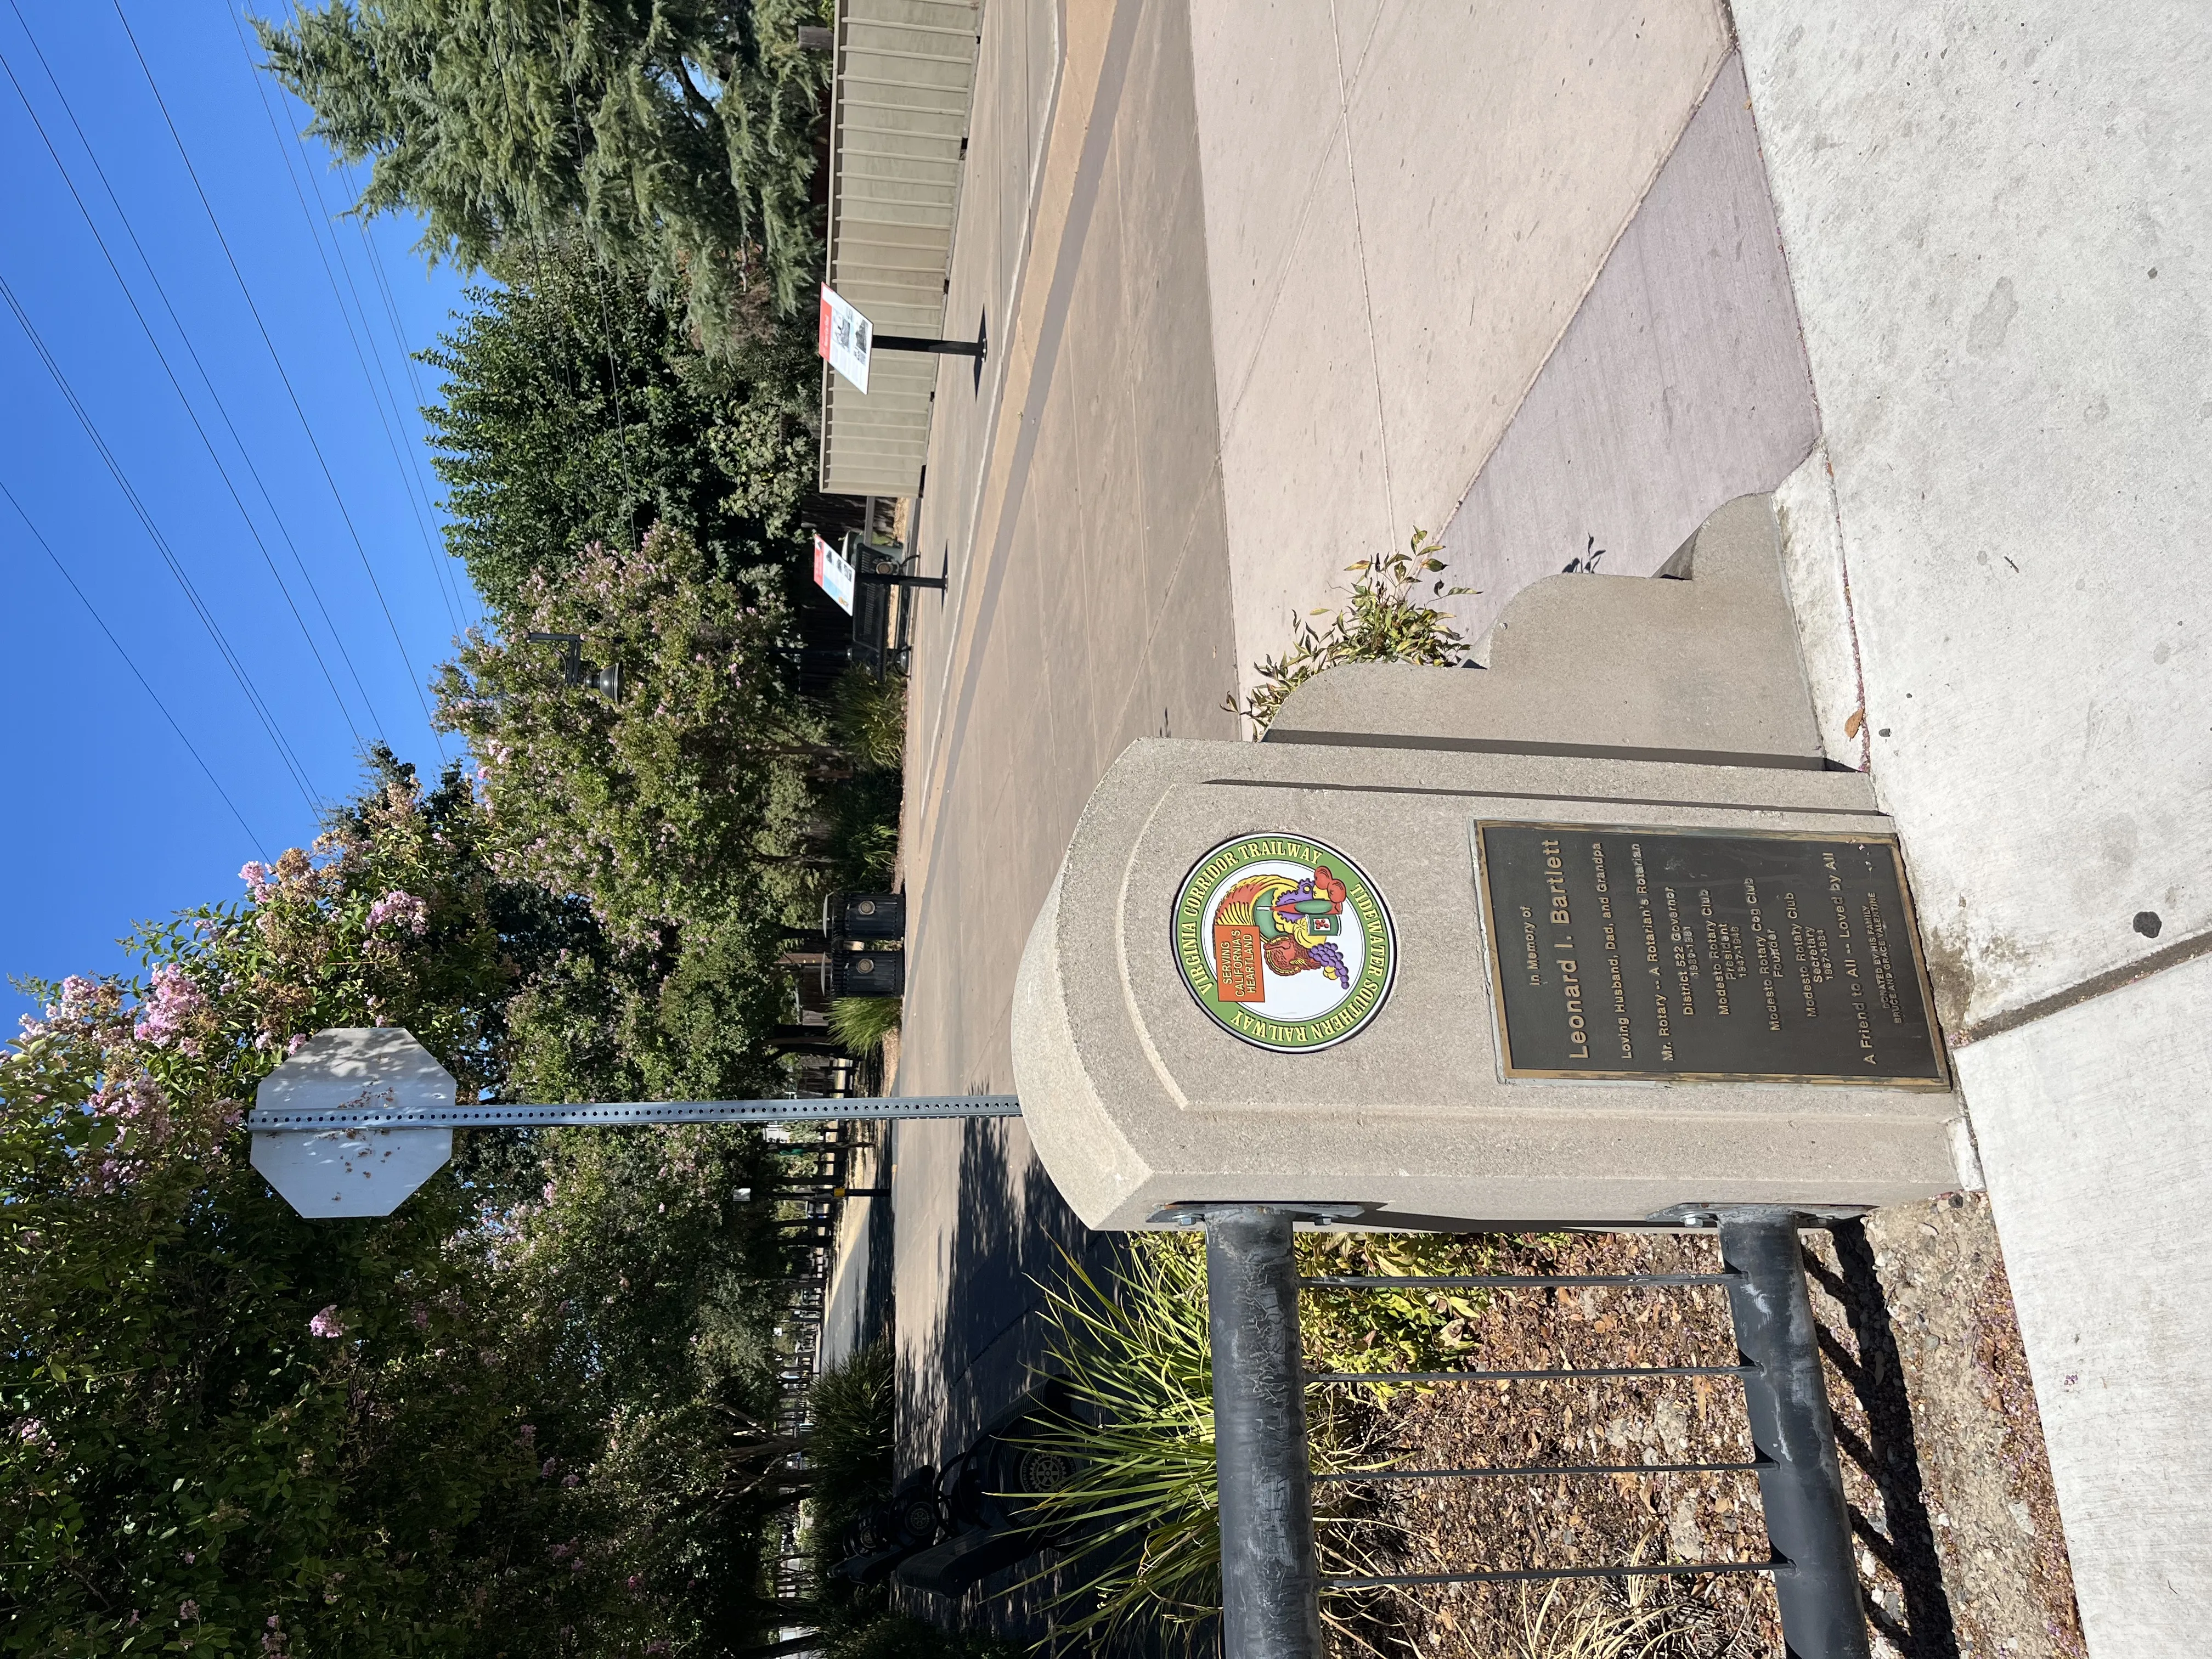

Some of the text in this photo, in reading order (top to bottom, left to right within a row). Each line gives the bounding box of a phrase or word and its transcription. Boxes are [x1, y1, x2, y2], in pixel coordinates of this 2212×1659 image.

[1630, 843, 1647, 894] Rotarian
[1822, 852, 1837, 870] All
[1827, 874, 1842, 891] by
[1181, 840, 1323, 995] VIRGINIA CORRIDOR TRAILWAY
[1520, 906, 1541, 985] In Memory of
[1639, 899, 1658, 962] Rotarian's
[1831, 896, 1850, 938] Loved
[1221, 941, 1232, 984] SERVING
[1230, 882, 1386, 1042] TIDEWATER SOUTHERN RAILWAY
[1231, 929, 1245, 997] CALIFORNIA'S
[1243, 934, 1256, 994] HEARTLAND
[1541, 839, 1588, 1058] Leonard I. Bartlett
[1591, 843, 1633, 1059] Loving Husband, Dad, and Grandpa
[1649, 966, 1661, 976] A
[1664, 887, 1694, 1015] District 522 Governor
[1699, 888, 1730, 1015] Modesto Rotary Club
[1718, 923, 1736, 980] President
[1731, 926, 1747, 978] 1947-1948
[1743, 877, 1781, 1031] Modesto Rotary Cog Club
[1767, 928, 1784, 978] Founder
[1784, 893, 1817, 1017] Modesto Rotary Club
[1804, 926, 1823, 983] Secretary
[1843, 959, 1858, 978] All
[1861, 905, 1891, 1009] DONATED BY HIS FAMILY
[1867, 892, 1903, 1024] BRUCE AND GRACE VALENTINE
[1654, 994, 1671, 1036] Rotary
[1849, 983, 1863, 997] to
[1661, 1041, 1674, 1061] Mr.
[1852, 1002, 1872, 1048] Friend
[1863, 1054, 1876, 1065] A
